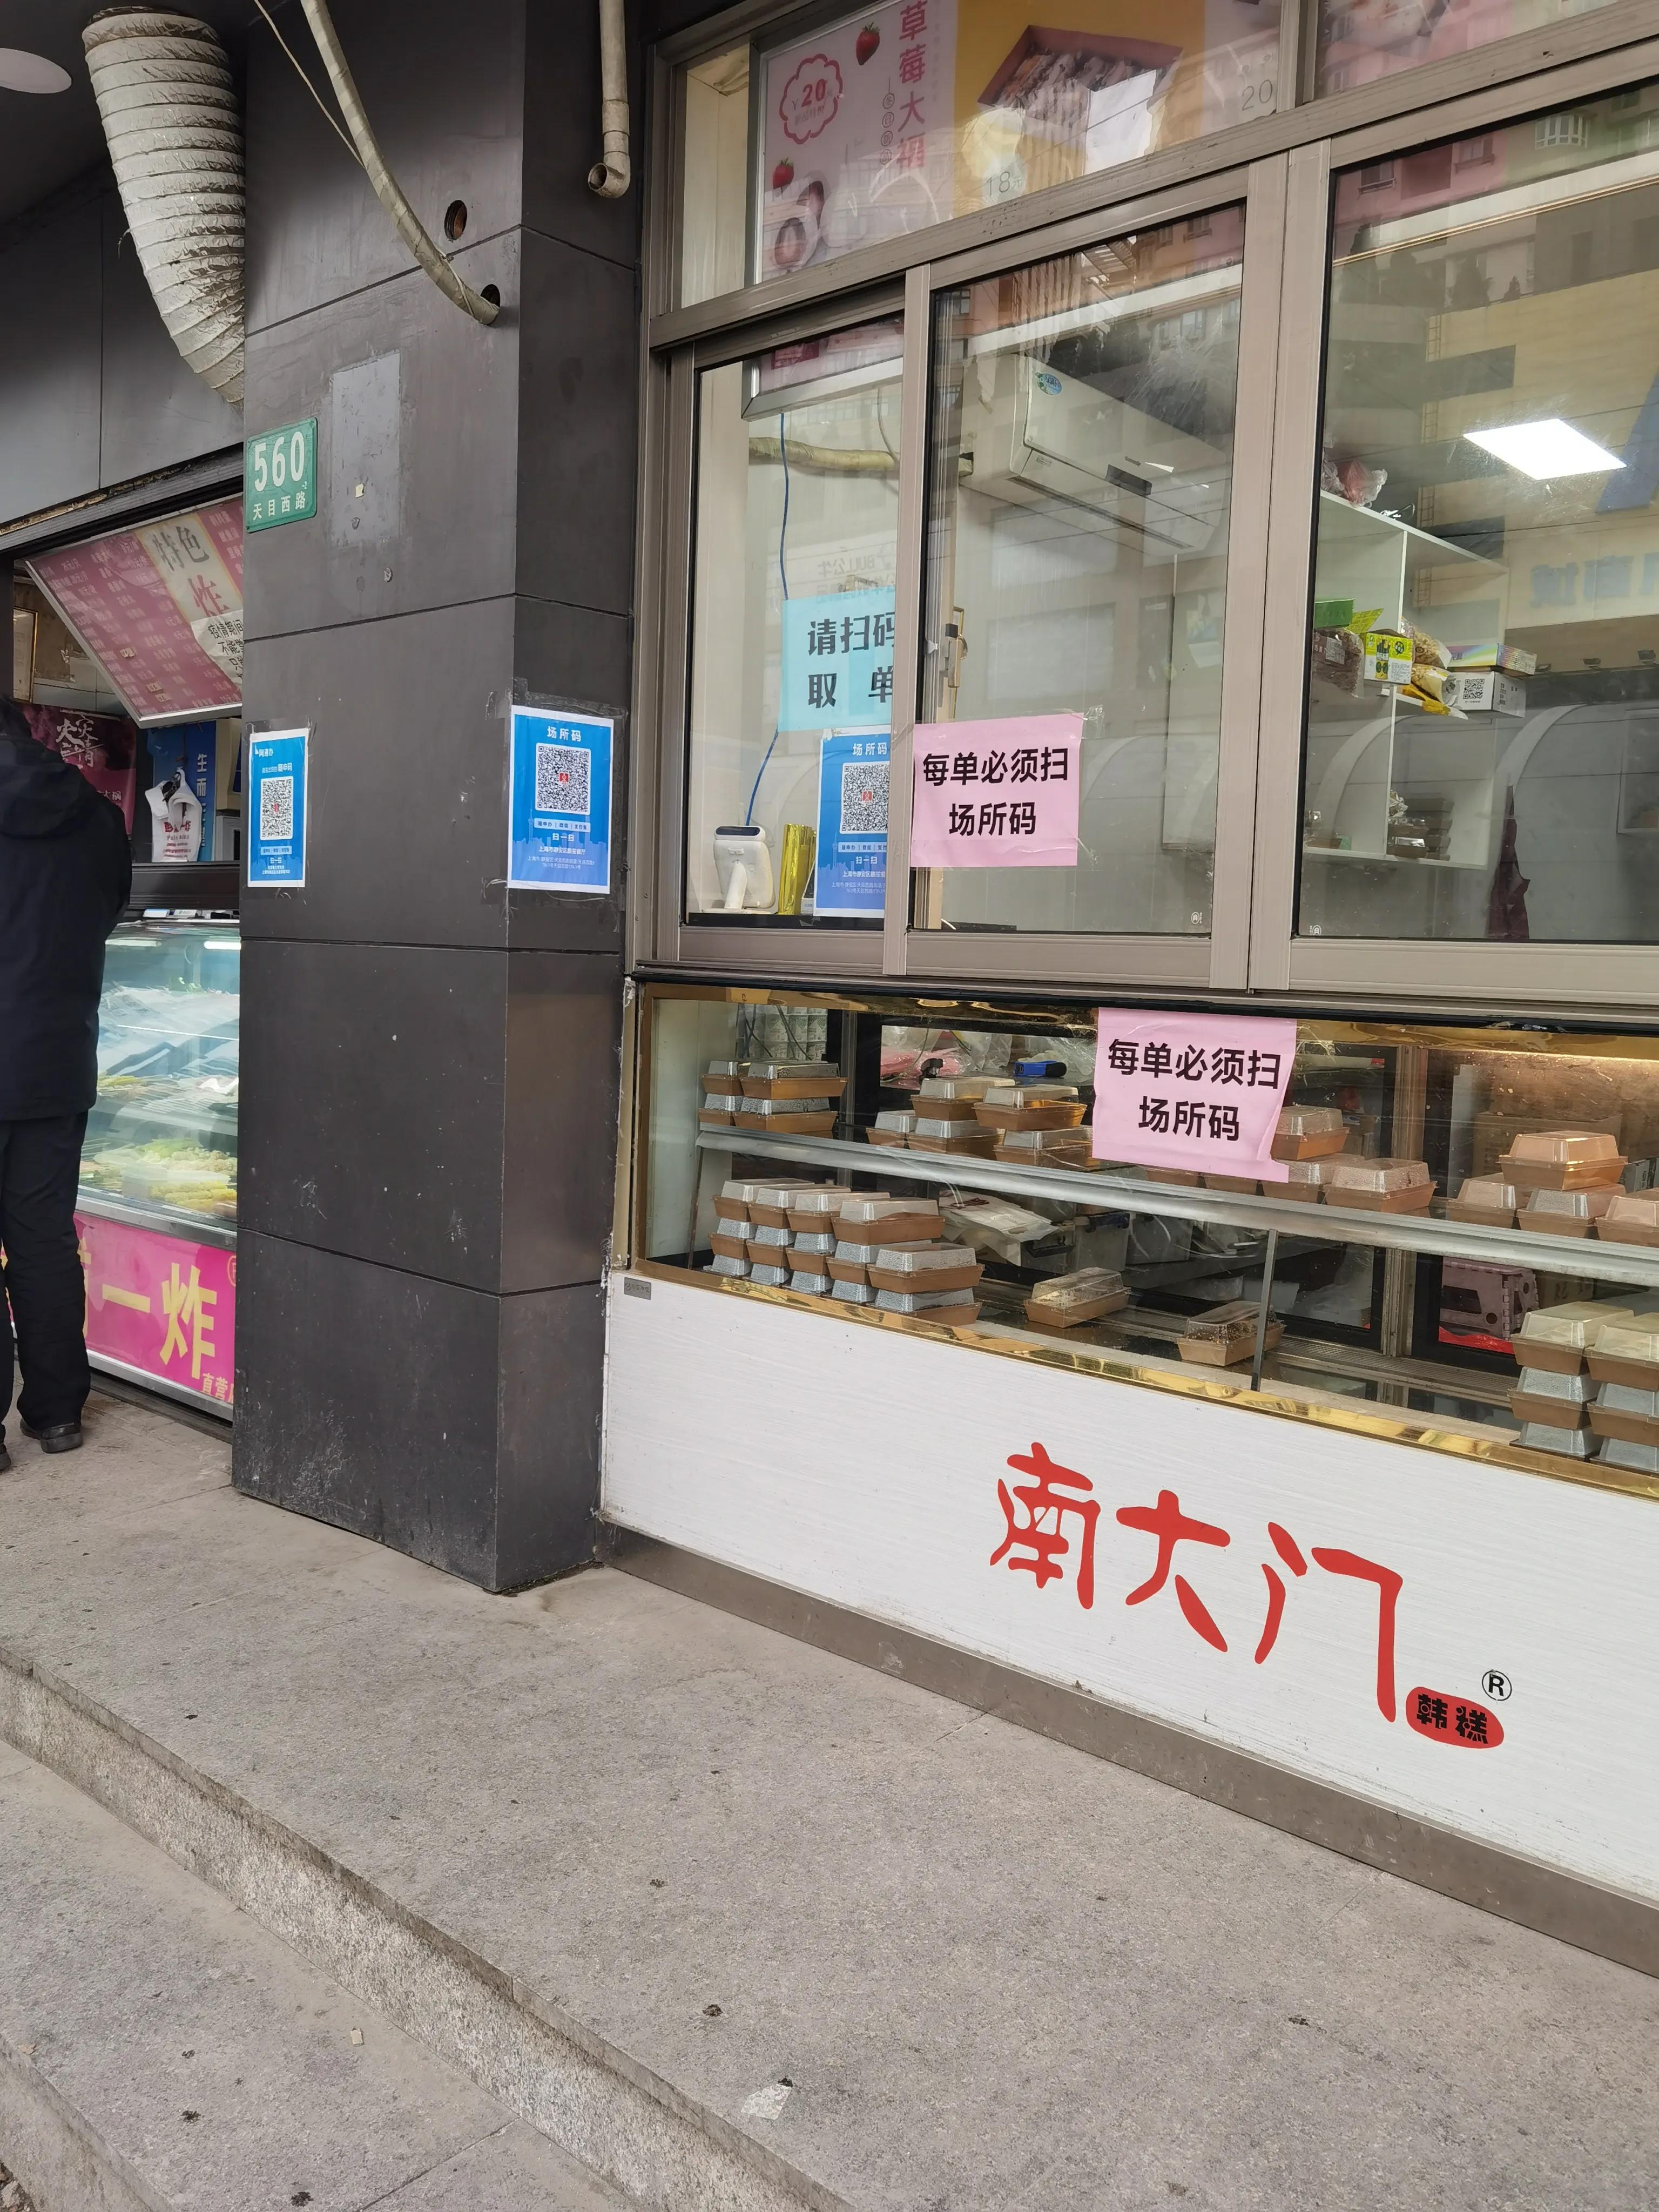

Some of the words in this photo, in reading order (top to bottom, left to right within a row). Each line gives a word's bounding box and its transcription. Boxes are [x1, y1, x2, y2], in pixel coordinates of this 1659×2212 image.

[896, 0, 927, 168] 草莓大福
[254, 431, 305, 492] 560
[253, 491, 306, 521] 天目西路
[807, 611, 895, 656] 请扫码
[547, 726, 582, 743] 场所码
[852, 742, 887, 756] 场所码
[922, 746, 1068, 786] 每单必须扫
[552, 833, 575, 842] 扫一扫
[949, 802, 1036, 836] 场所码
[855, 856, 878, 864] 扫一扫
[1108, 1038, 1281, 1089] 每单必须扫
[1138, 1095, 1240, 1141] 场所码
[989, 1441, 1403, 1723] 南大门
[1415, 1694, 1490, 1745] 韩糕
